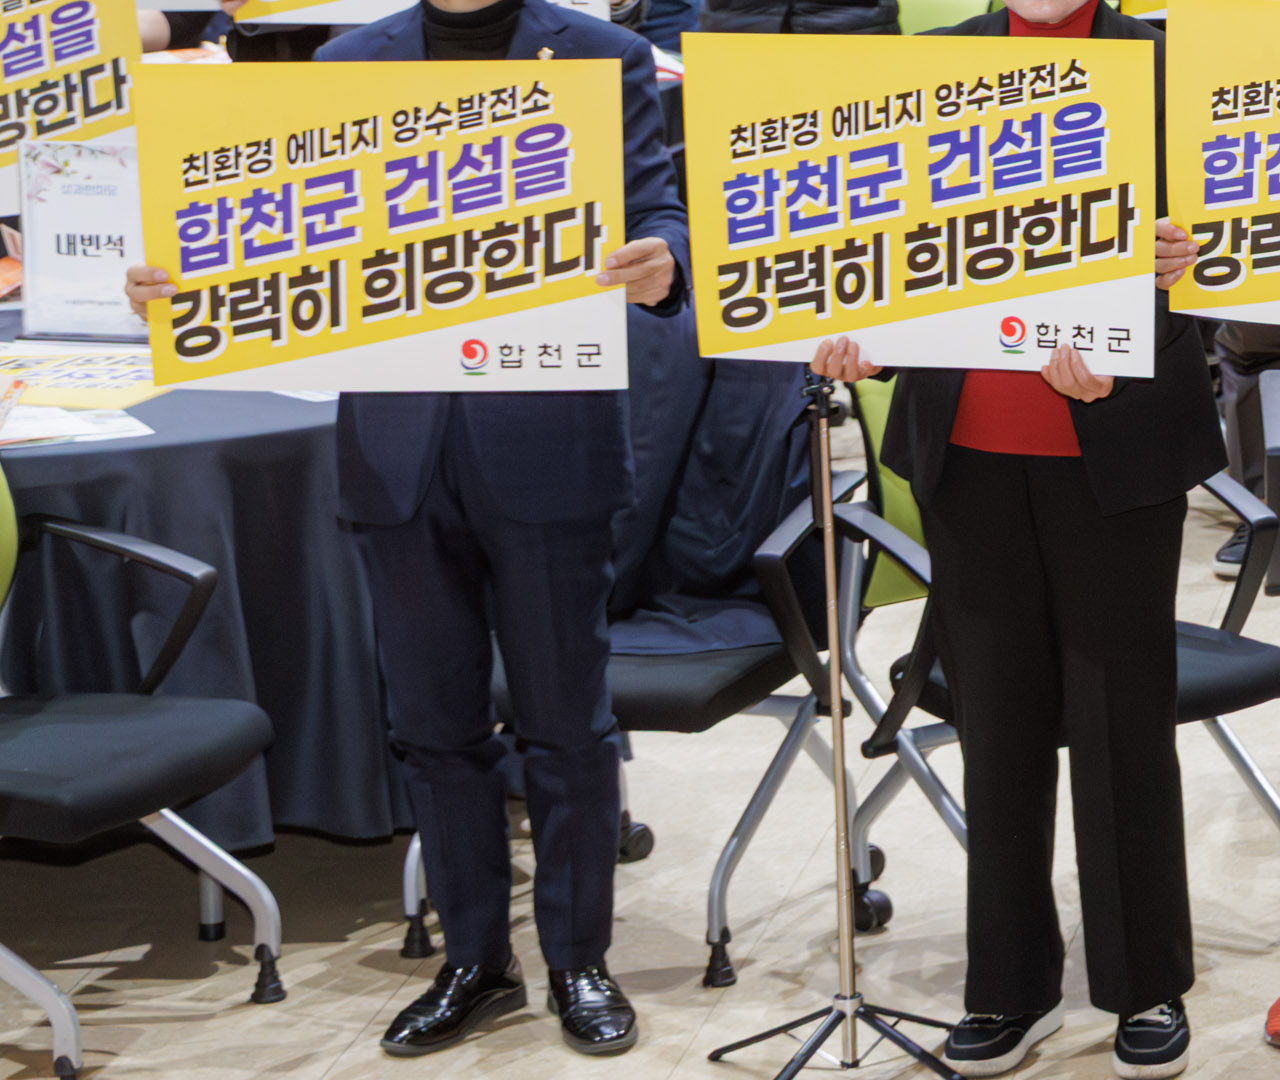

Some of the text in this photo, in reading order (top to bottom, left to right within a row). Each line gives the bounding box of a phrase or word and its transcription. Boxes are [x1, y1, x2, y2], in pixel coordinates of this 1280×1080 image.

[182, 81, 553, 190] 친환경 에너지 양수발전소
[723, 102, 1107, 246] 합천군 건설을
[730, 59, 1090, 160] 친환경 에너지 양수발전소
[56, 231, 126, 259] 내빈석
[176, 122, 573, 274] 합천군 건설을
[718, 183, 1137, 328] 강력히 희망한다
[171, 203, 607, 362] 강력히 희망한다
